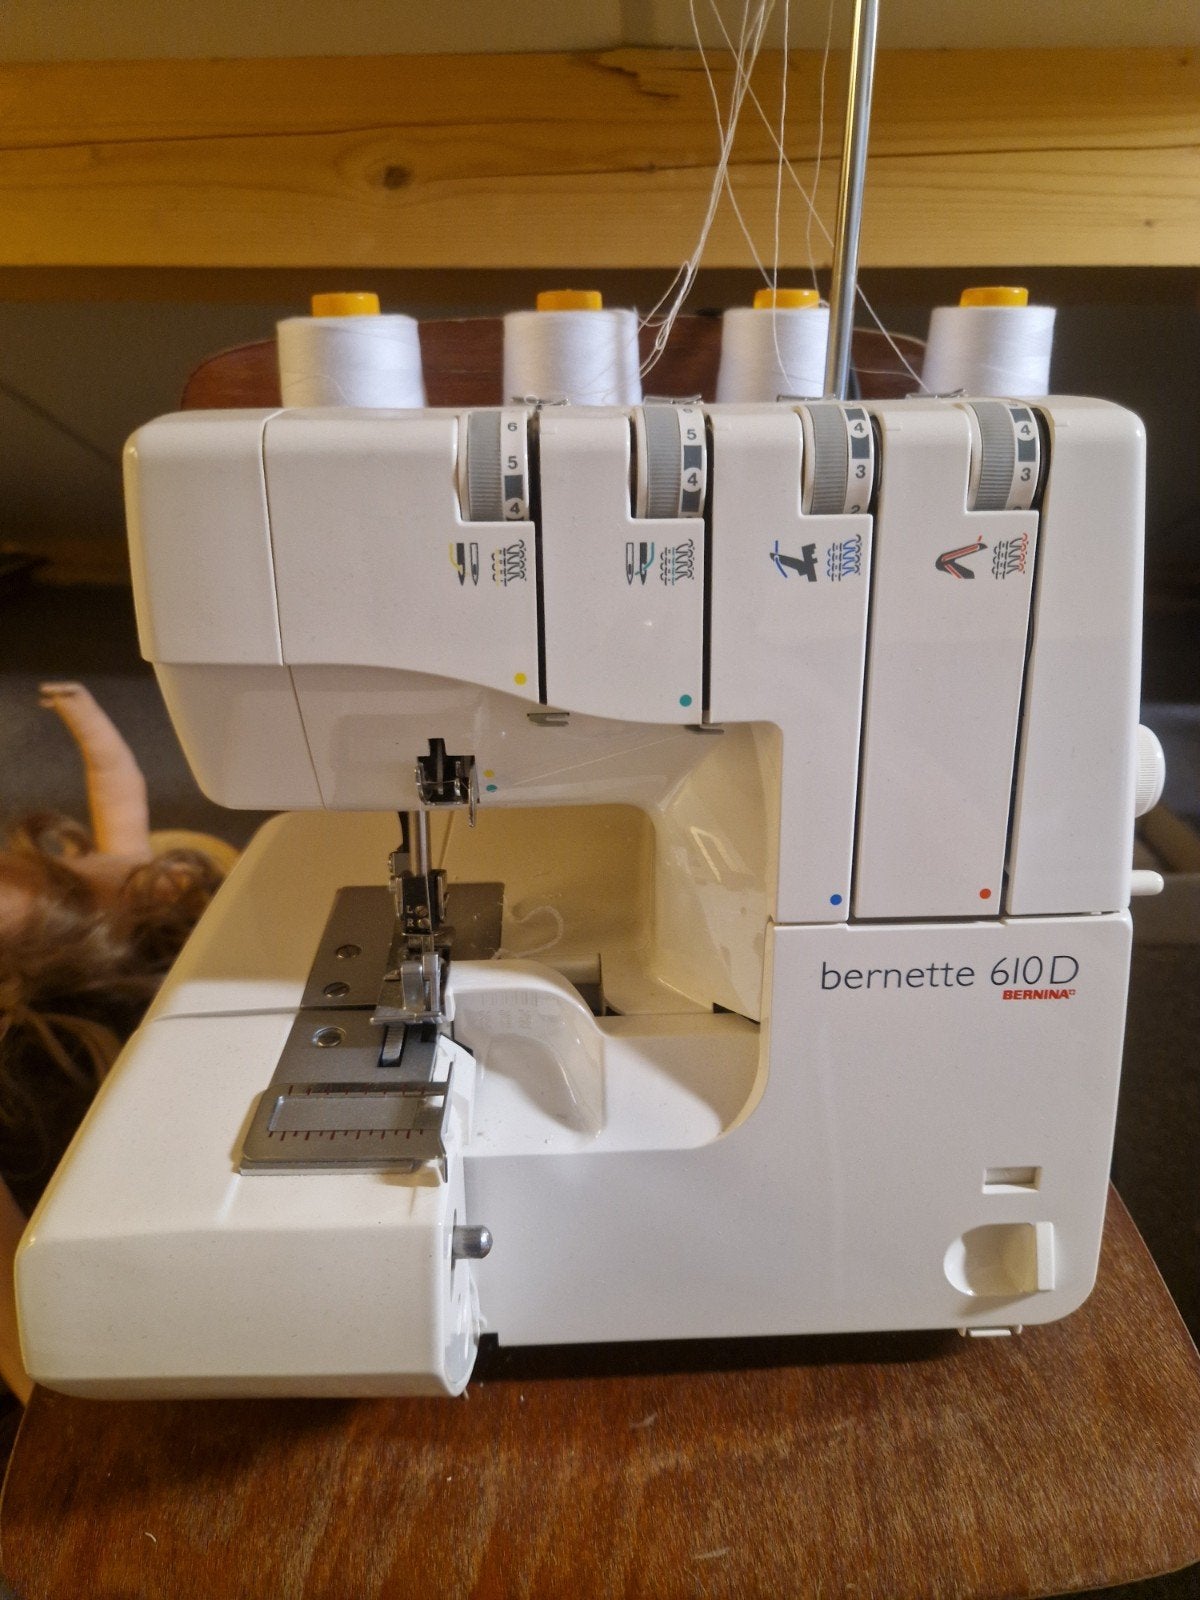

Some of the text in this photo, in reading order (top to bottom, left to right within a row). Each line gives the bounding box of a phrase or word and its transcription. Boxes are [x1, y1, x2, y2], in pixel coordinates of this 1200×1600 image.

[507, 422, 518, 432] 6
[854, 422, 865, 433] 4
[1020, 424, 1031, 435] 4
[686, 429, 697, 440] 5
[508, 455, 518, 469] 5
[855, 465, 866, 479] 3
[1020, 468, 1031, 482] 3
[687, 472, 698, 486] 4
[510, 502, 520, 515] 4
[406, 905, 414, 914] L
[407, 918, 415, 927] R
[821, 961, 975, 990] bernette
[1002, 989, 1069, 1000] BERNINA
